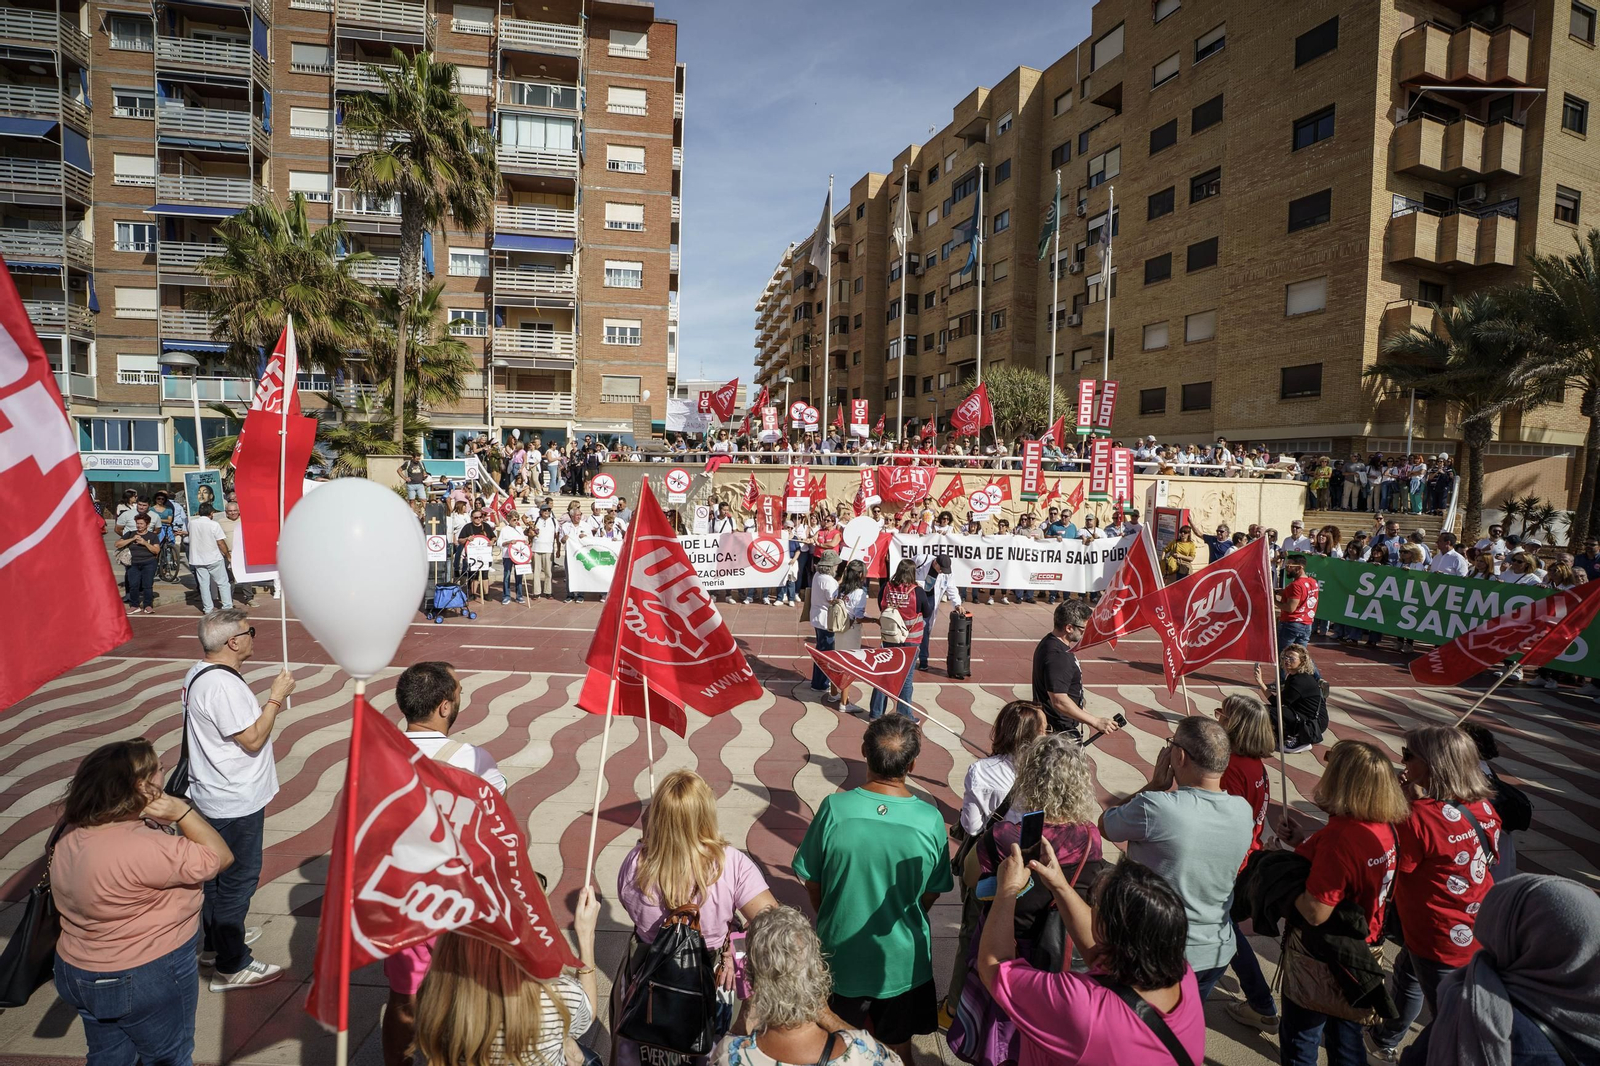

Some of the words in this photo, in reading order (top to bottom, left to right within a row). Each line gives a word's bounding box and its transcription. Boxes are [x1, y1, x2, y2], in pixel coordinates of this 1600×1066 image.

[700, 392, 710, 413] UGT
[855, 401, 865, 424] UGT
[1080, 382, 1093, 426] CCOO
[1099, 383, 1116, 426] CCOO
[765, 408, 775, 430] UGT
[100, 458, 123, 466] TERRAZA
[123, 458, 140, 466] COSTA
[1026, 442, 1039, 492] CCOO
[1093, 440, 1109, 491] CCOO
[1115, 450, 1127, 499] CCOO
[793, 468, 806, 497] UGT
[862, 470, 875, 497] UGT
[704, 539, 720, 548] LA
[901, 545, 918, 558] EN
[923, 544, 982, 560] DEFENSA
[986, 547, 1004, 560] DE
[1008, 547, 1062, 563] NUESTRA
[690, 552, 737, 564] ÚBLICA:
[698, 568, 746, 578] ZACIONES
[1355, 572, 1536, 619] SALVEMO
[1344, 594, 1385, 625] LA
